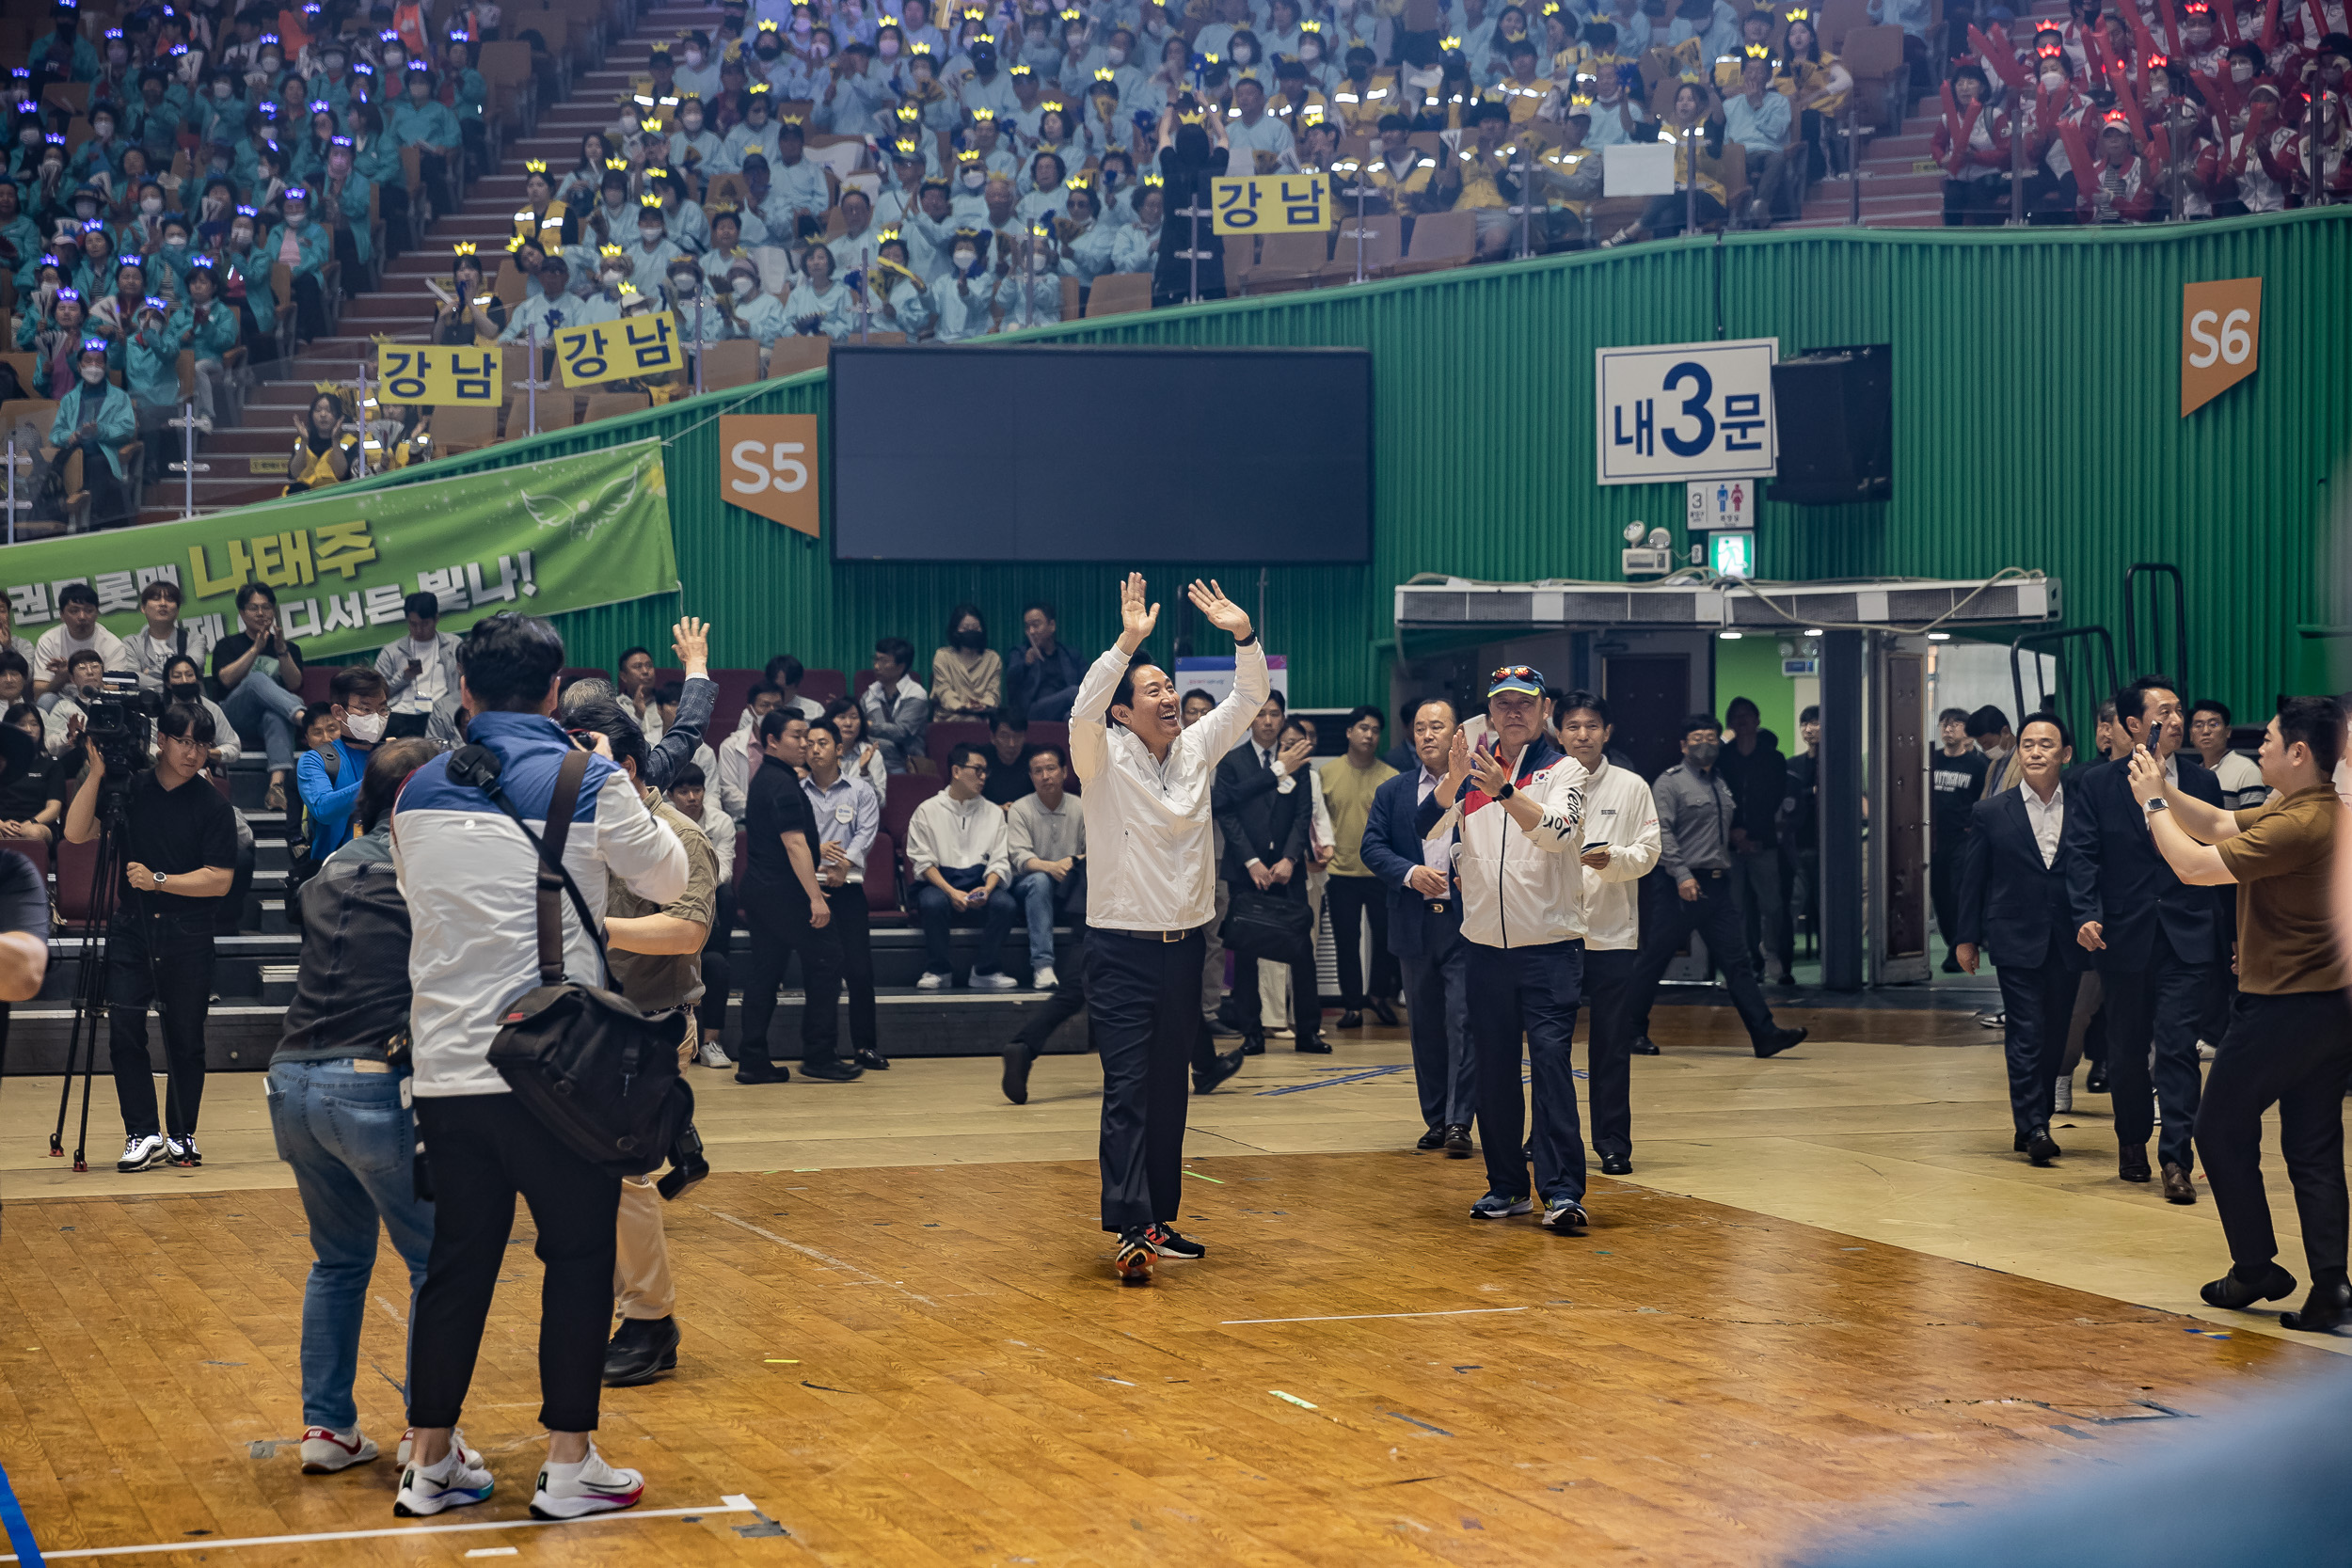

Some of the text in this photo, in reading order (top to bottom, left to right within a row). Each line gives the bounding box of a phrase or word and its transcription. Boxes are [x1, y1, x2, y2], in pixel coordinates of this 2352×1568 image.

[2189, 309, 2251, 369] S6
[731, 439, 808, 495] S5
[1692, 492, 1702, 509] 3
[188, 519, 376, 598] 나태주
[417, 549, 537, 613] 빛나!
